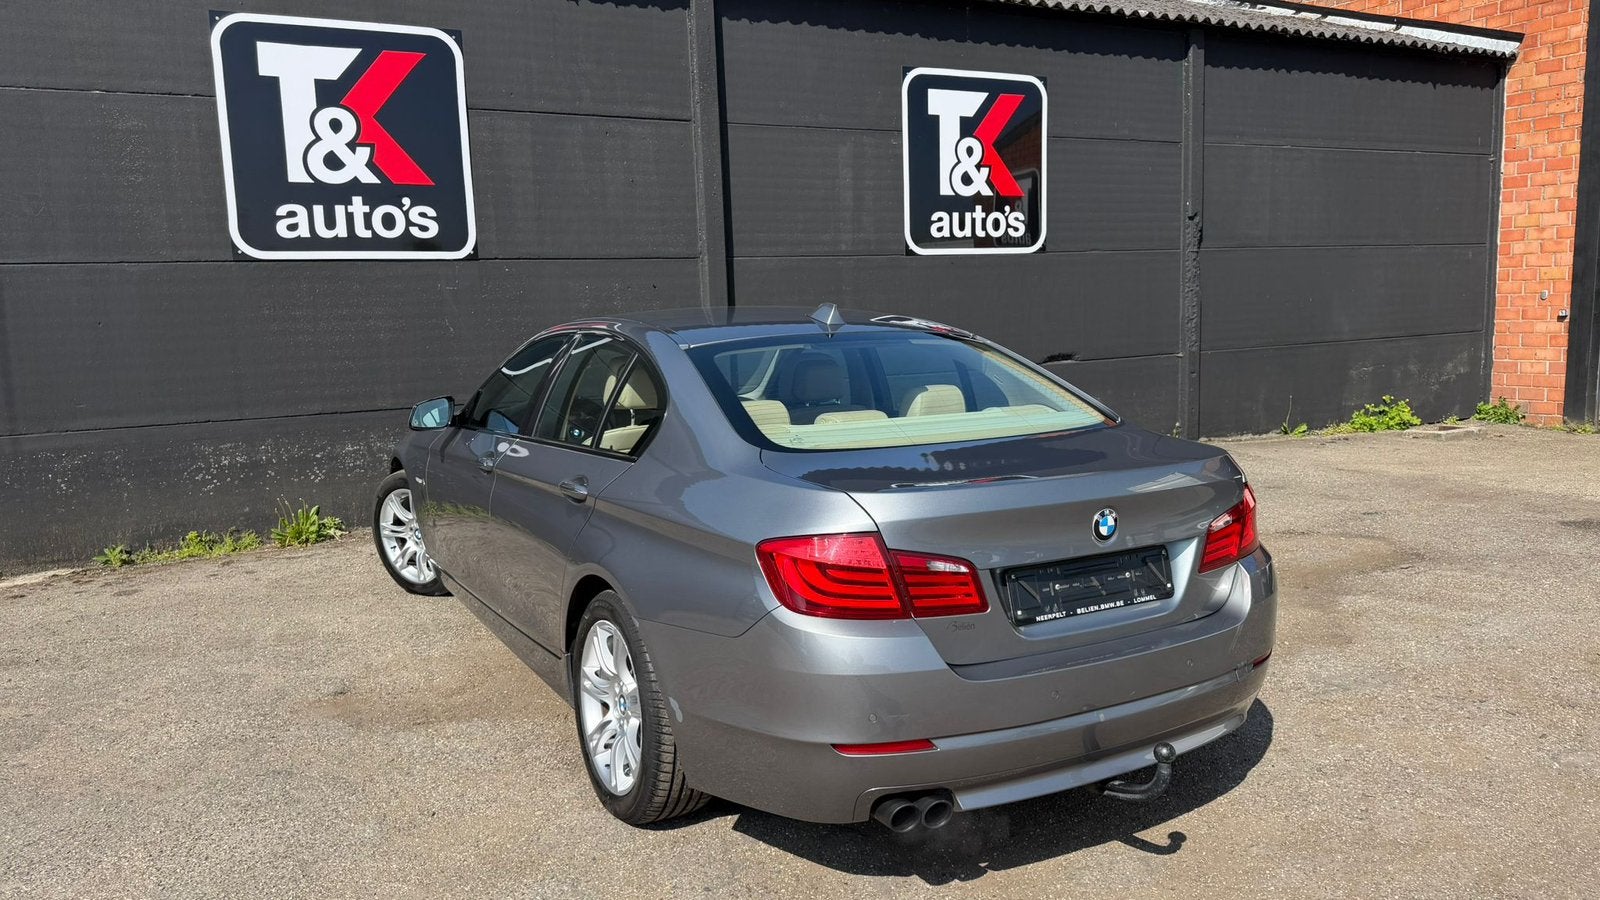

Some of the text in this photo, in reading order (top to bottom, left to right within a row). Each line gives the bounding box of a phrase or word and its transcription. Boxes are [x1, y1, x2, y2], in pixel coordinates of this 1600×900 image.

[256, 41, 435, 185] T&K
[928, 88, 1025, 197] T&K
[275, 196, 439, 239] auto's
[930, 205, 1026, 238] auto's
[1035, 611, 1067, 622] NEERPELT
[1076, 600, 1125, 615] BELIEN.BMW.BE
[1133, 594, 1157, 604] LOMMEL
